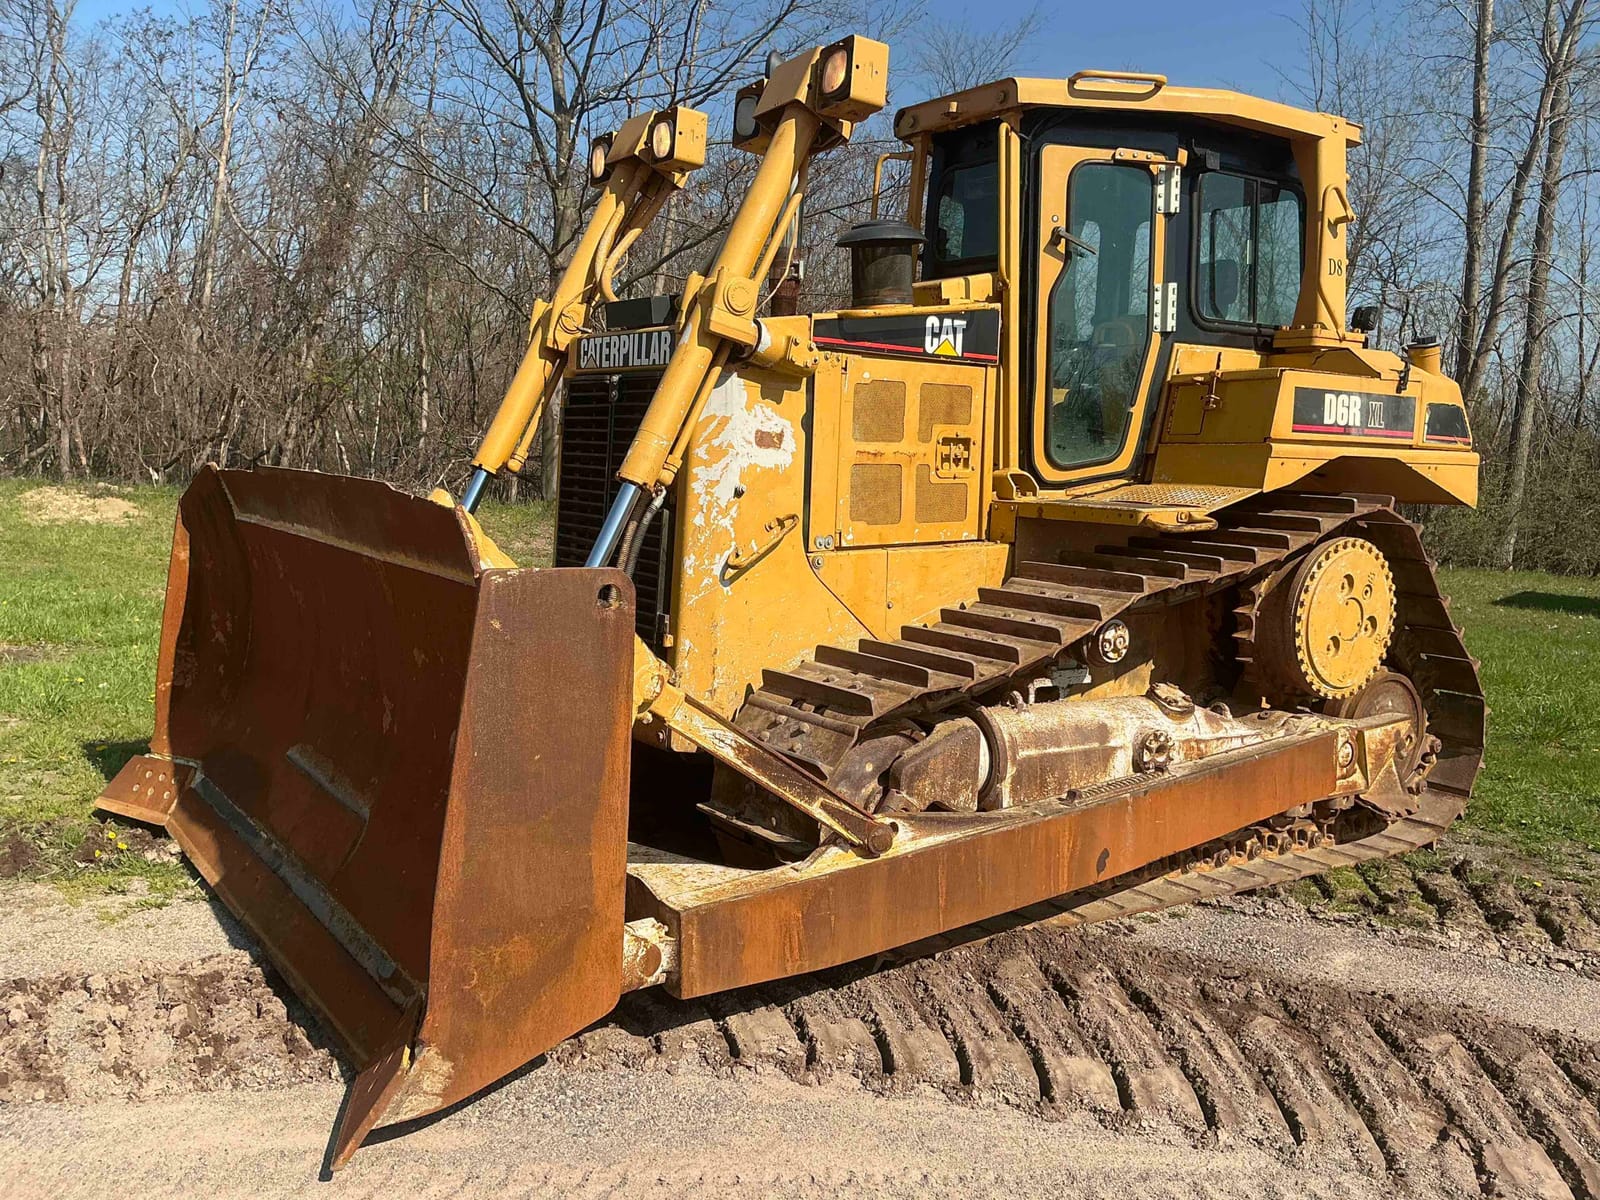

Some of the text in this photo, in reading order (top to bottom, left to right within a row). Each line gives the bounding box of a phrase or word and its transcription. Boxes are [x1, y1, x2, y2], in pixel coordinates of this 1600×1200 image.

[580, 330, 672, 369] CATERPILLAR
[924, 315, 967, 357] CAT
[1323, 393, 1385, 428] D6R XL
